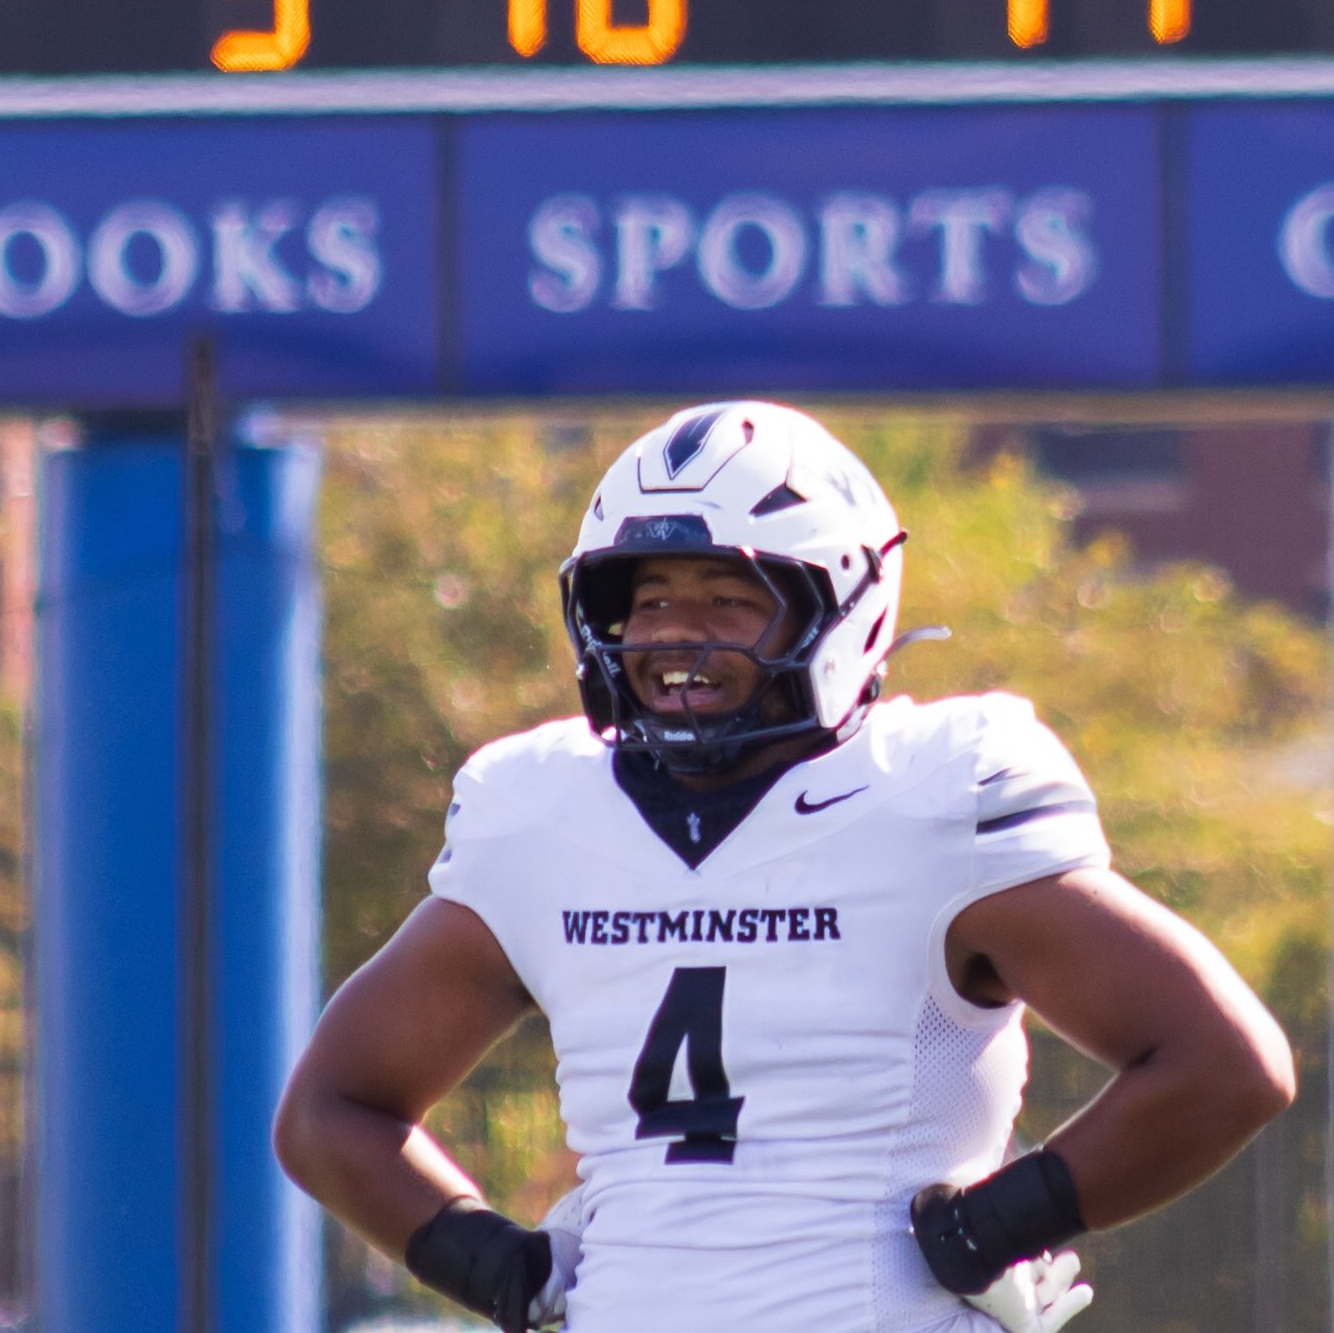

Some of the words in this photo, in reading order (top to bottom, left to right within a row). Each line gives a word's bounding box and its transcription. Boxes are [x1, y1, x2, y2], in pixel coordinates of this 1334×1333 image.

[527, 186, 1095, 314] SPORTS
[562, 908, 841, 944] WESTMINSTER
[628, 966, 745, 1165] 4
